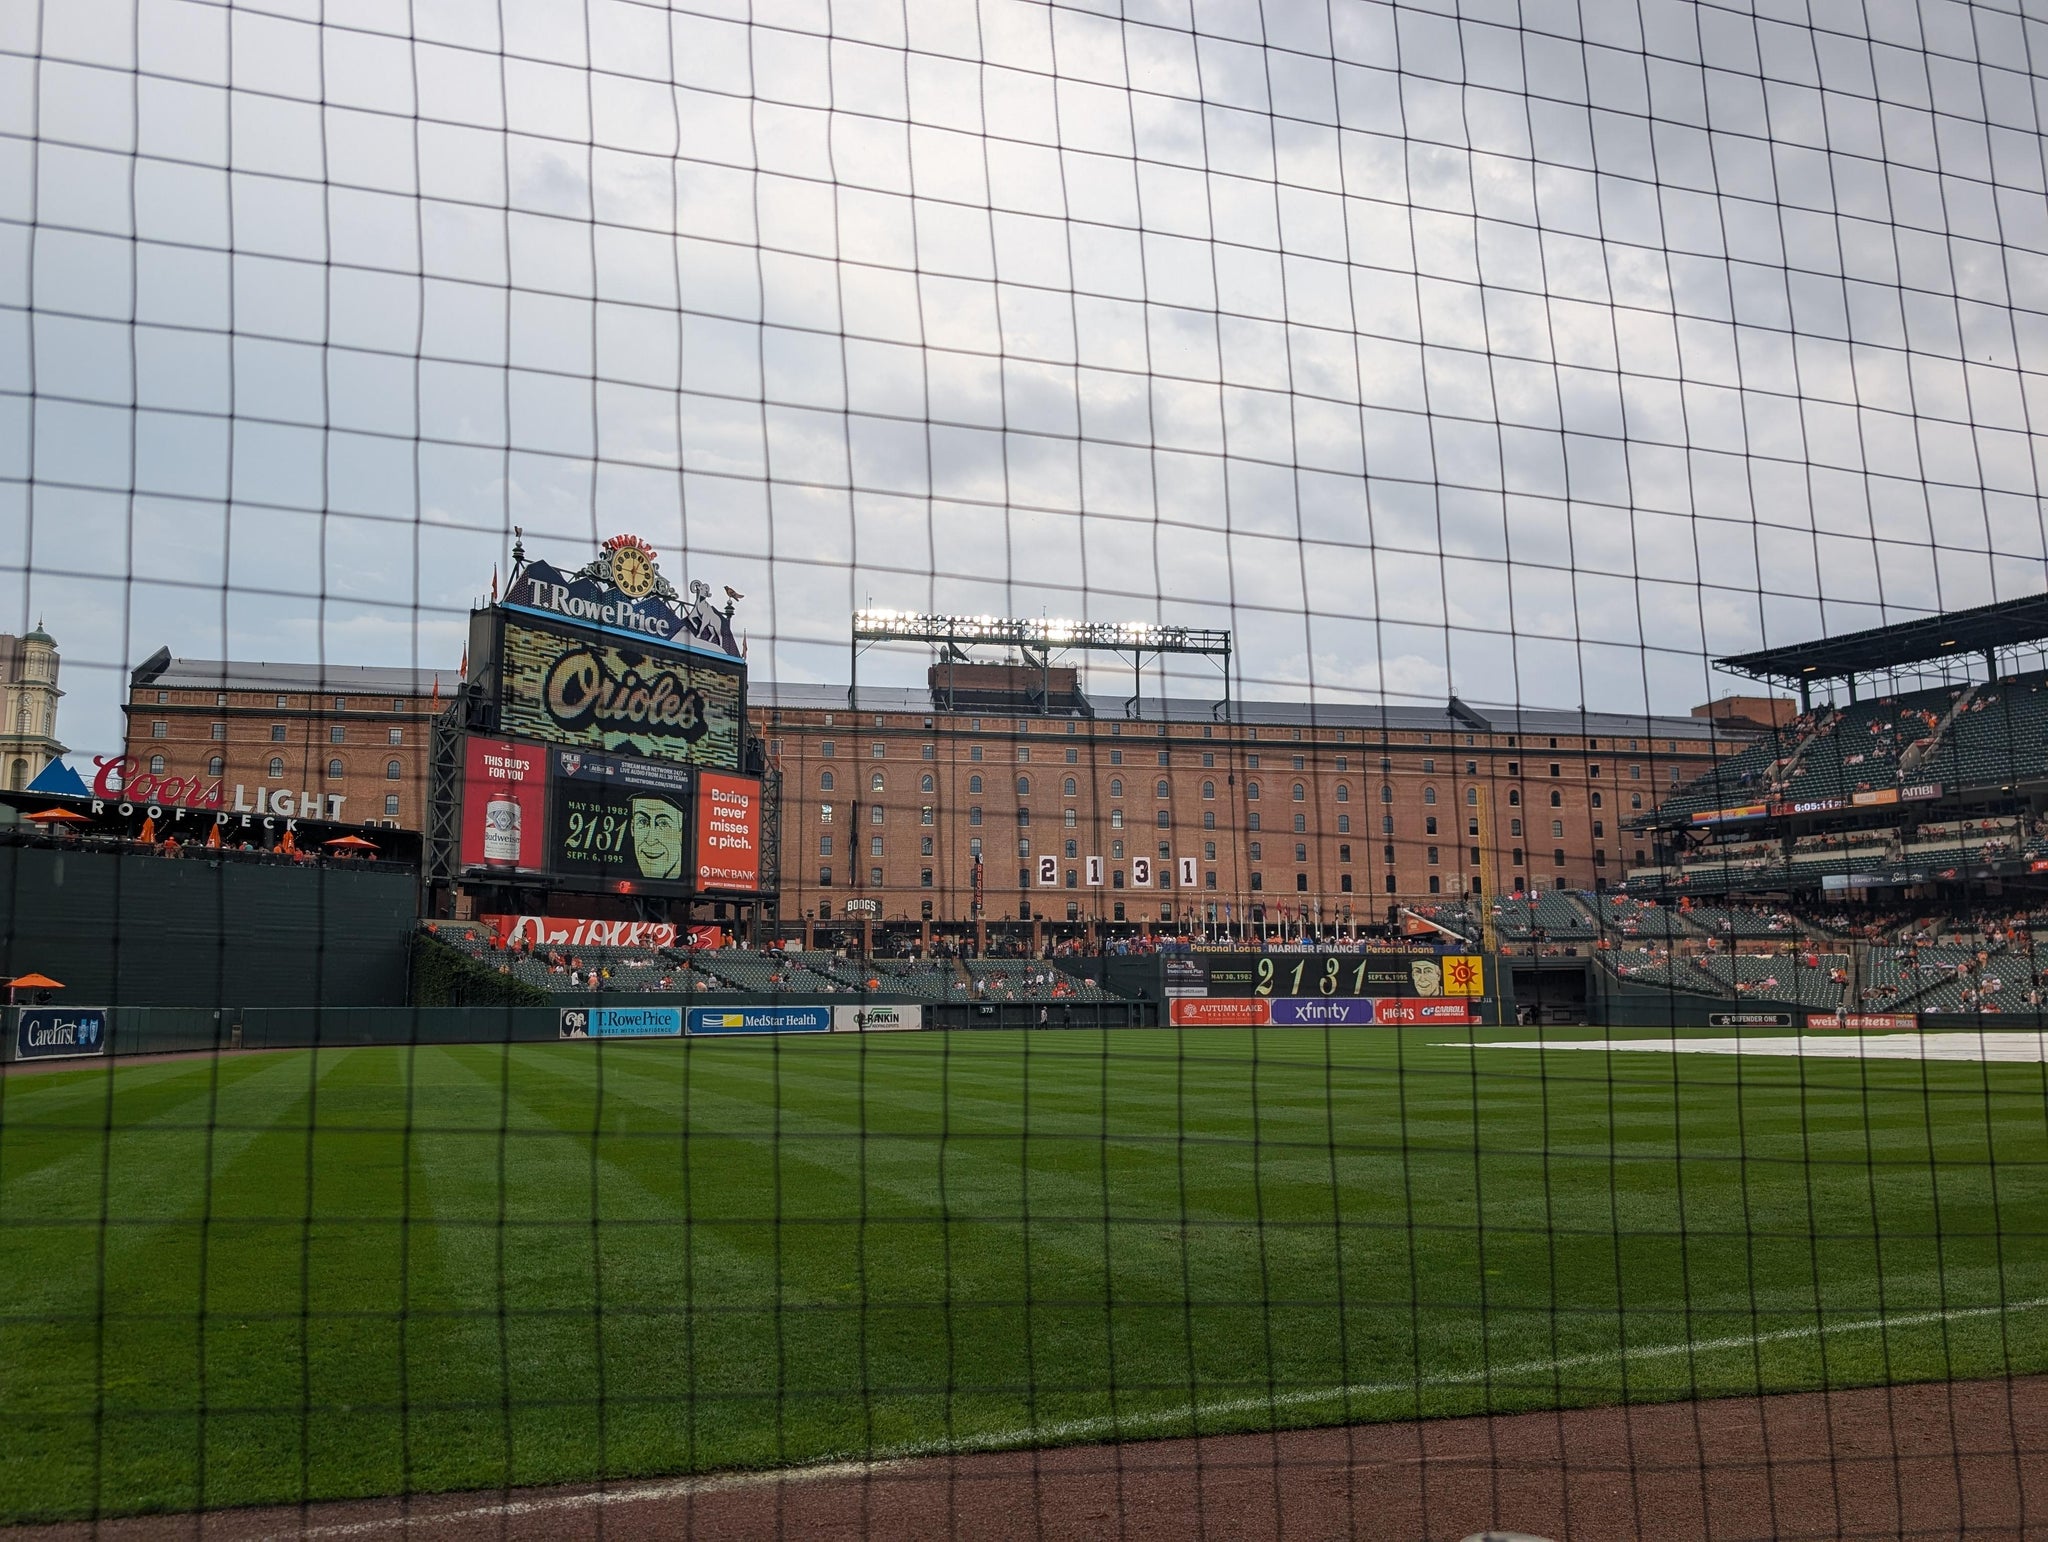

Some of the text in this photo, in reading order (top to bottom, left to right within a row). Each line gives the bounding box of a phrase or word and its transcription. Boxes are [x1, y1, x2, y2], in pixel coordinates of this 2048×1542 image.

[548, 648, 699, 730] Orioles
[484, 754, 530, 771] THIS BUD'S
[562, 753, 580, 761] MLB
[489, 767, 524, 781] FOR YOU
[93, 755, 348, 821] Coors LIGHT
[1902, 785, 1934, 797] AMBI
[711, 788, 749, 808] Boring
[568, 801, 587, 812] MAY
[607, 804, 629, 816] 1982
[713, 805, 747, 819] never
[1794, 800, 1833, 812] 6:05:11
[91, 800, 297, 832] ROOF DECK
[564, 812, 629, 853] 2131
[710, 820, 749, 835] misses
[485, 831, 520, 844] Budweise
[709, 835, 752, 852] a pitch.
[566, 850, 588, 862] SEPT.
[603, 854, 624, 864] 1995
[711, 867, 756, 880] PNC BANK
[1041, 859, 1192, 883] 2 1 3 1
[1190, 944, 1261, 953] Personal Loans
[1268, 945, 1360, 954] MARINER FINANCE
[1366, 945, 1434, 954] Personal Loans
[1255, 958, 1367, 996] 2 1 3 1
[1200, 1004, 1263, 1012] AUTUMN LAKE
[1295, 1002, 1350, 1021] xfinity
[1382, 1008, 1415, 1020] HIGH'S
[745, 1013, 817, 1027] MedStar Health
[868, 1013, 899, 1023] RANKIN
[1810, 1017, 1838, 1026] weis
